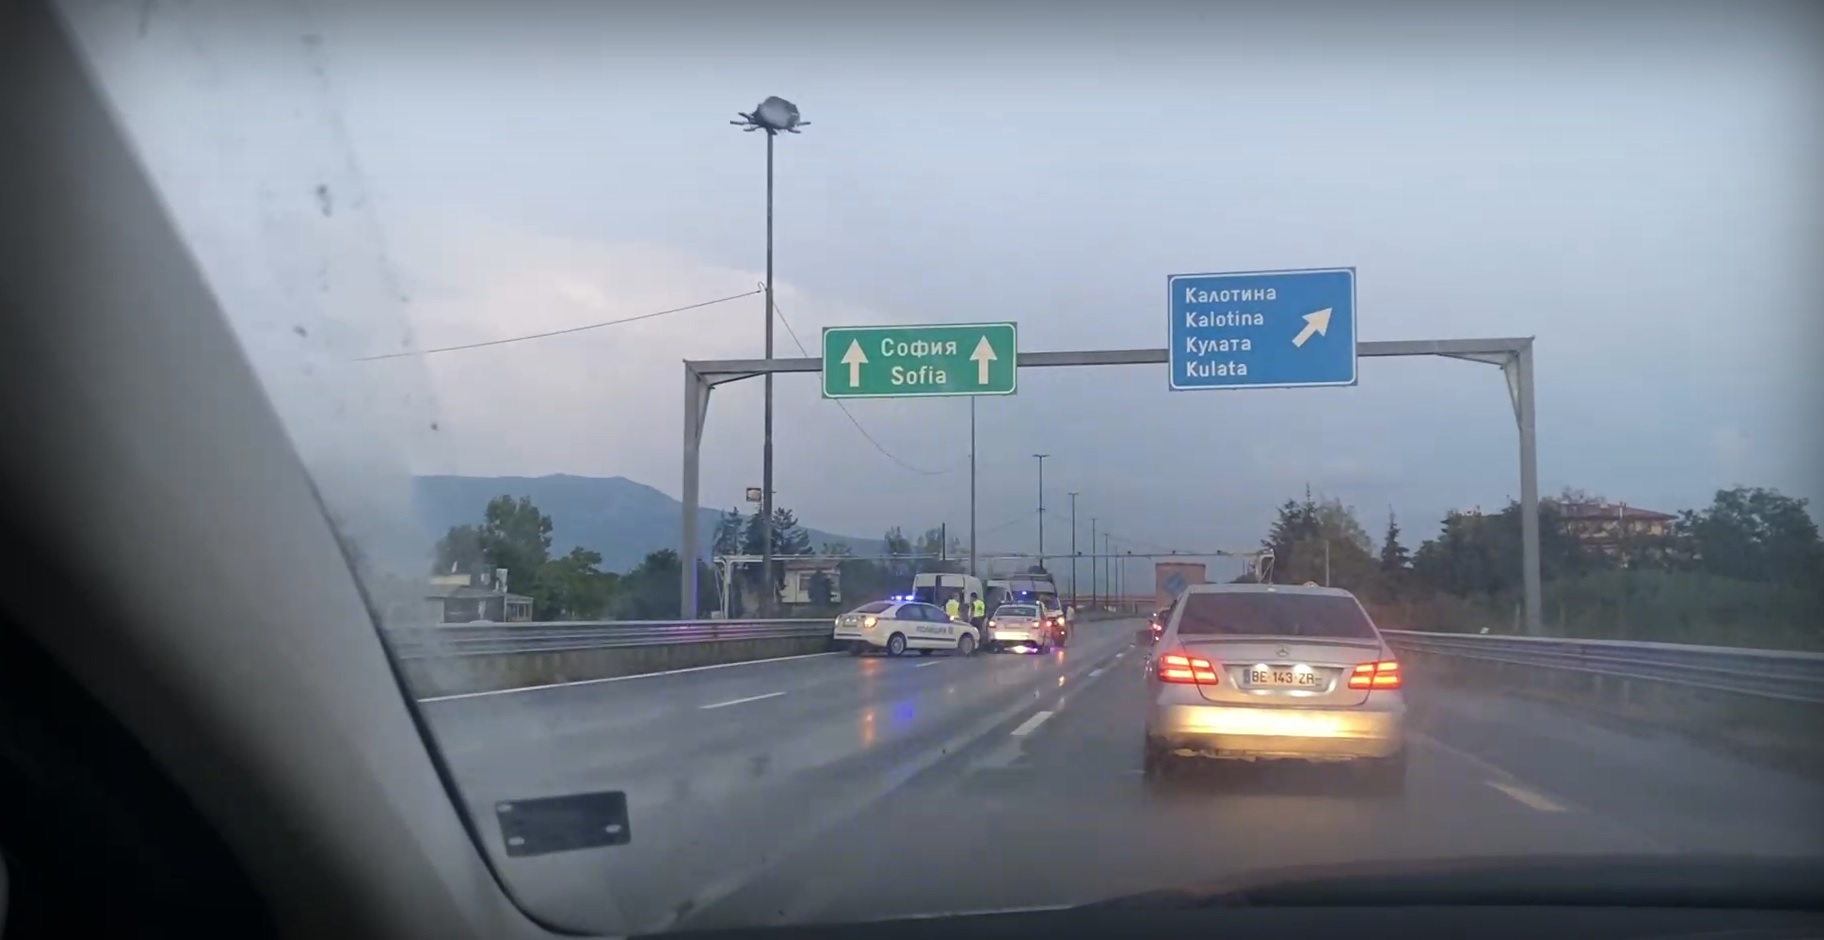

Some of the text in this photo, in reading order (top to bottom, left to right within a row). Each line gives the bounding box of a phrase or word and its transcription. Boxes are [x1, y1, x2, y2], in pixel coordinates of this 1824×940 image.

[1186, 288, 1276, 303] Калотина
[1186, 311, 1264, 328] Kalotina
[881, 338, 957, 358] София
[1186, 336, 1252, 356] Кулата
[891, 366, 946, 385] Sofia
[1186, 361, 1248, 377] Kulata
[1273, 671, 1293, 684] 143
